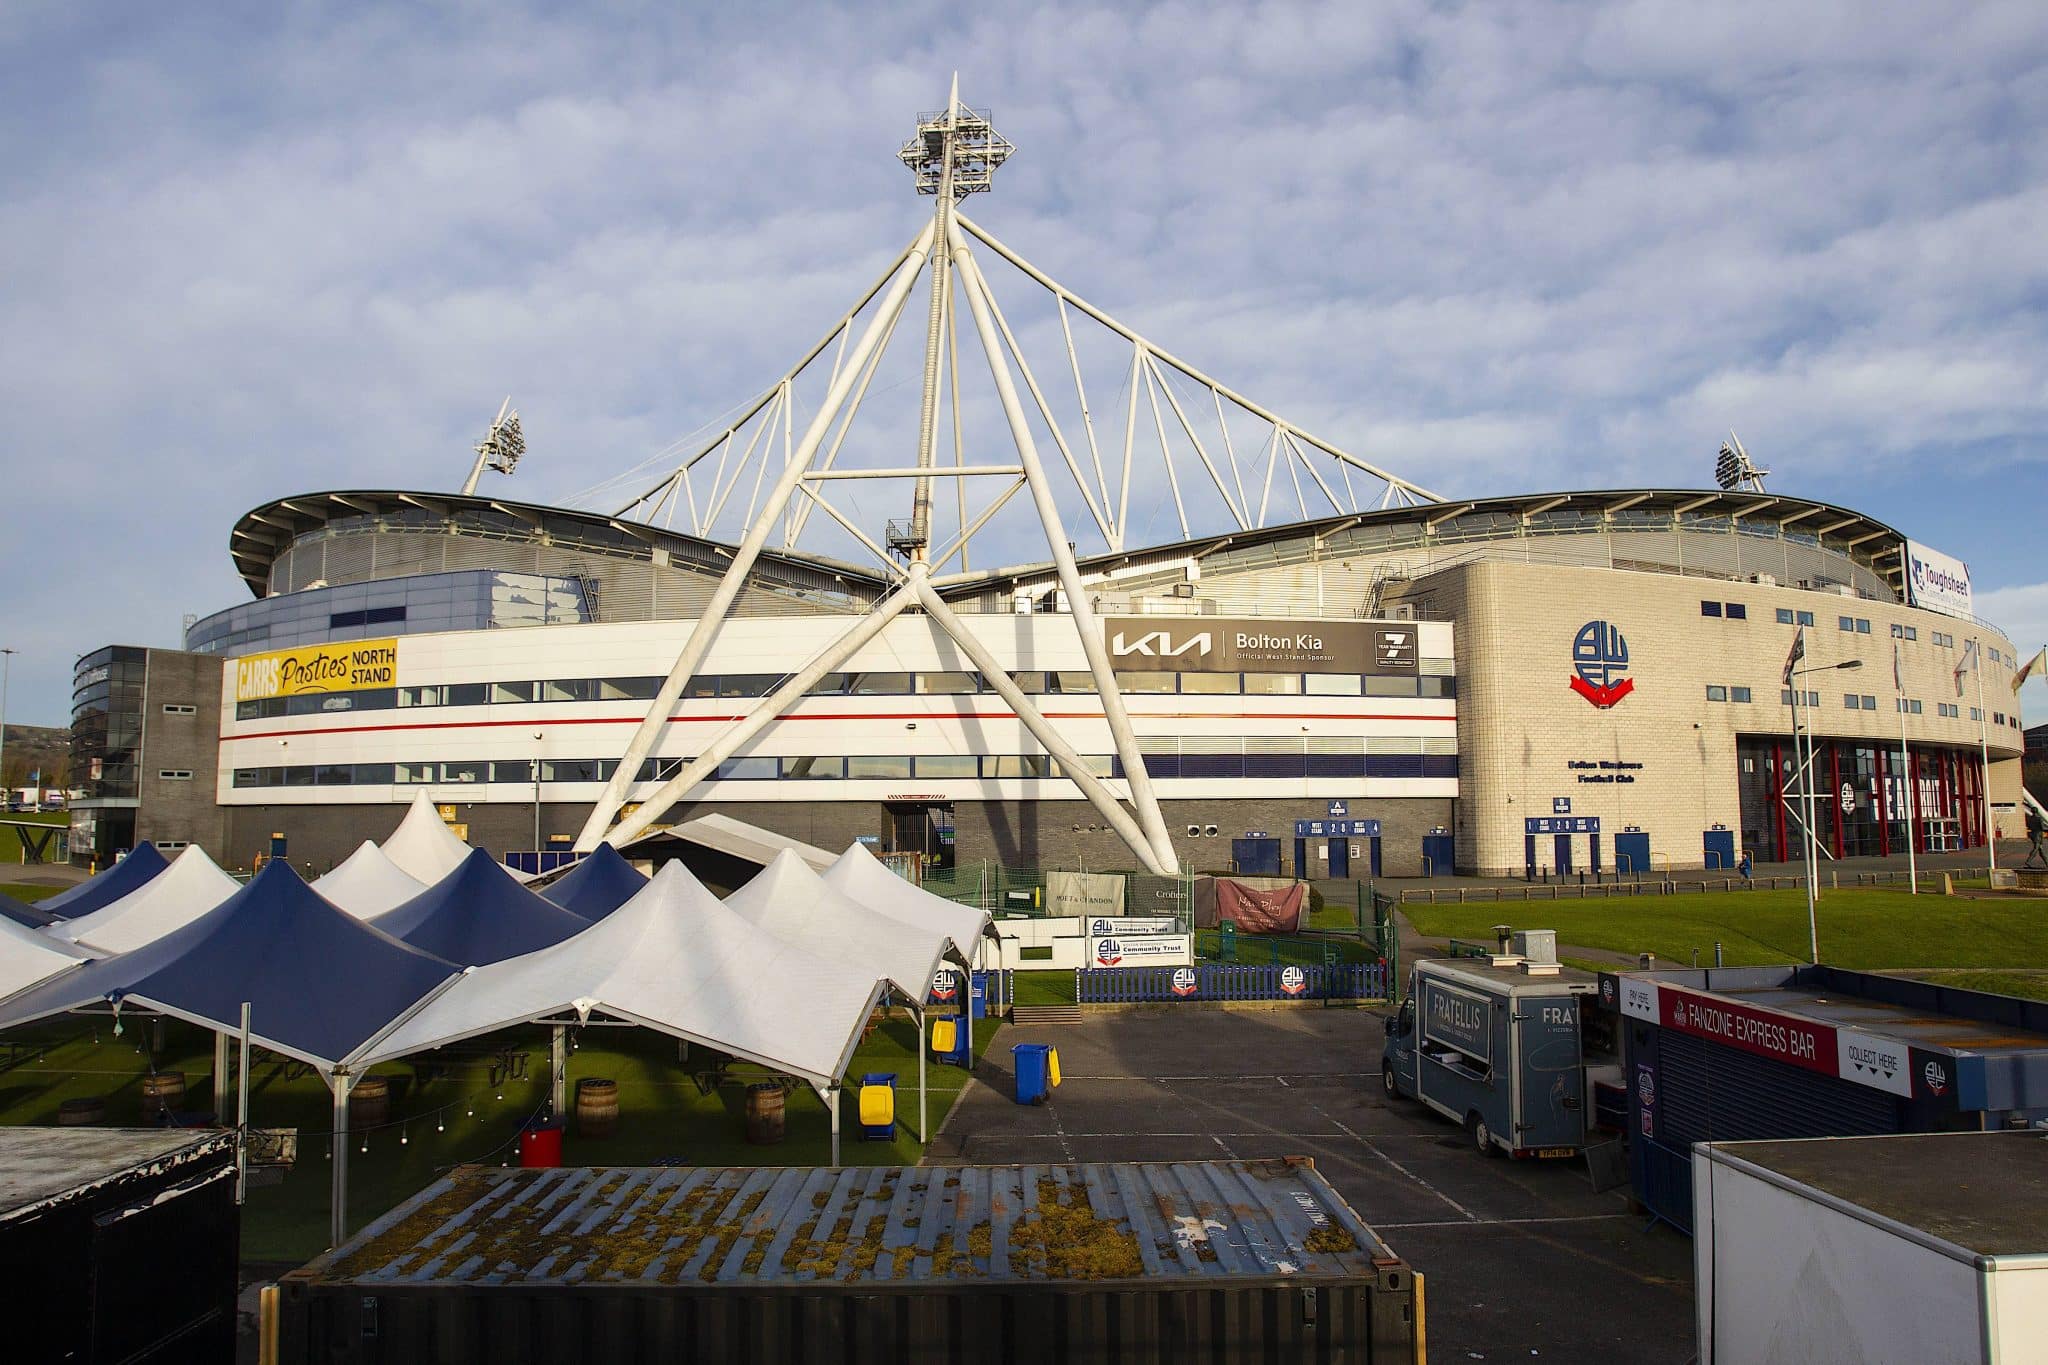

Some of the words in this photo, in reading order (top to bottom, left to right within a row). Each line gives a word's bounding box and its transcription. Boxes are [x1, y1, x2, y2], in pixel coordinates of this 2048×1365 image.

[1925, 563, 1968, 597] Toughsheet
[1236, 633, 1291, 649] Bolton
[1296, 634, 1323, 650] Kia
[281, 652, 349, 689] Pasties
[352, 648, 395, 666] NORTH
[1236, 652, 1264, 660] Official
[1308, 654, 1335, 662] Sponsor
[238, 657, 280, 699] CARRS
[351, 667, 391, 685] STAND
[1434, 993, 1480, 1030] FRATELLIS
[1688, 1003, 1733, 1037] FANZONE
[1736, 1016, 1786, 1053] EXPRESS
[1790, 1029, 1816, 1061] BAR
[1848, 1045, 1877, 1065] COLLECT
[1879, 1054, 1898, 1071] HERE
